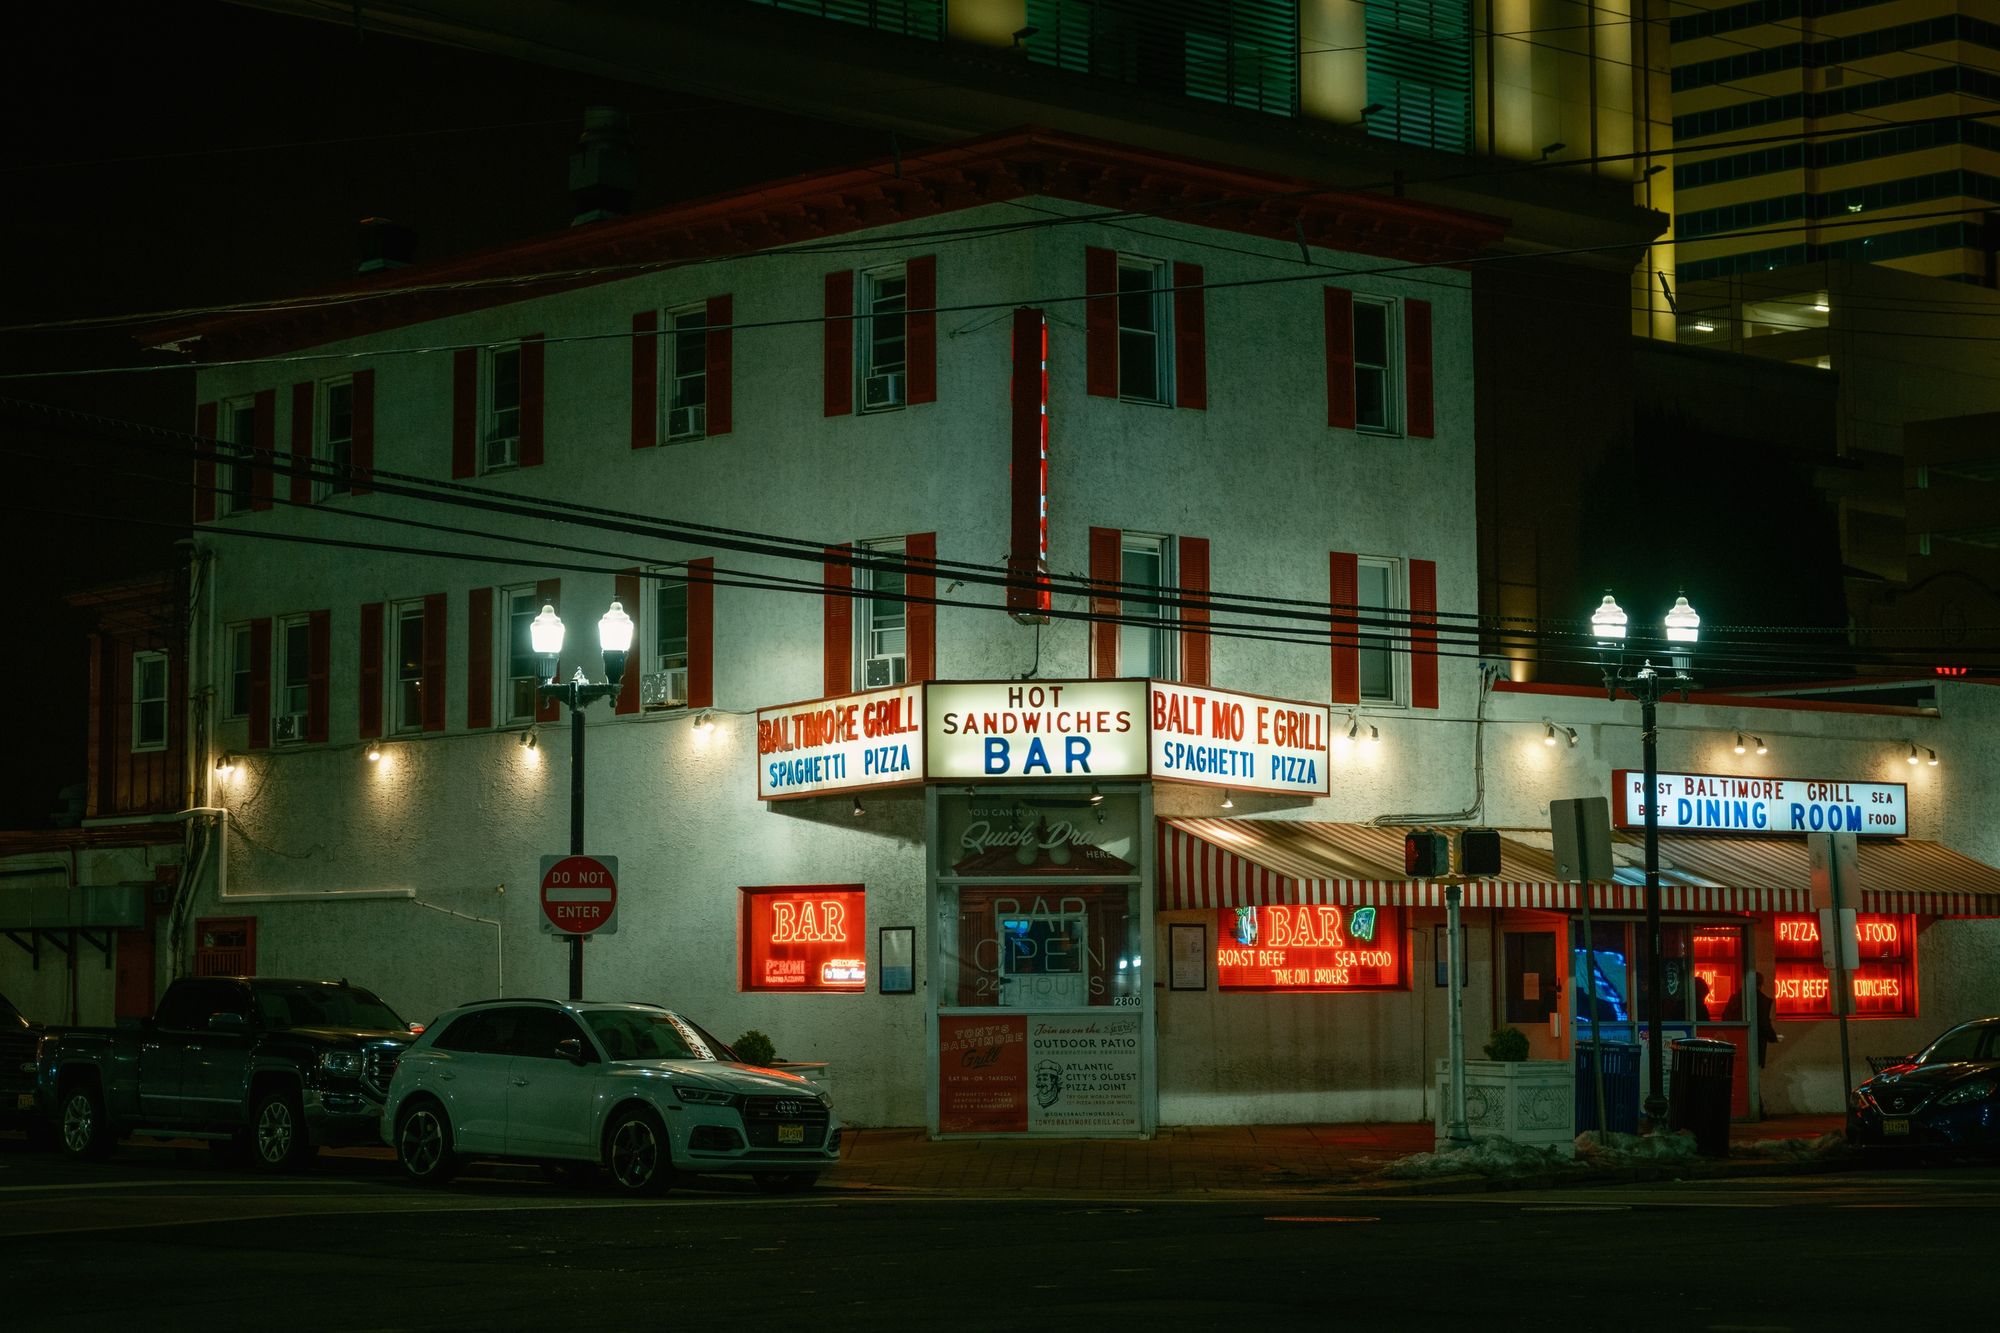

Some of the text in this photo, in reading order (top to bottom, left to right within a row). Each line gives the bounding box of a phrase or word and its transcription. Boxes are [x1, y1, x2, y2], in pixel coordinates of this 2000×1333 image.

[1008, 686, 1063, 708] HOT
[759, 696, 918, 755] BALTIMORE GRILL
[943, 711, 1131, 734] SANDWICHES
[984, 736, 1091, 774] BAR
[1164, 741, 1317, 784] SPAGHETTI PIZZA
[769, 744, 910, 788] SPAGHETTI PIZZA
[1634, 782, 1672, 795] RST
[1685, 777, 1854, 802] BALTIMORE GRILL
[1872, 792, 1893, 804] SEA
[968, 808, 1040, 817] YOU CAN PLAY
[1638, 804, 1668, 817] BEF
[1678, 798, 1862, 832] DINING ROOM
[1868, 813, 1896, 825] FOOD
[960, 820, 1104, 855] Quick Dra
[1086, 850, 1112, 859] HERE
[552, 872, 605, 884] DO NOT
[558, 906, 600, 918] ENTER
[994, 896, 1087, 933] BAR
[772, 901, 846, 942] BAR
[1268, 906, 1343, 947] BAR
[1780, 922, 1818, 941] PIZZA
[1866, 924, 1897, 942] FOOD
[974, 937, 1106, 973] OPEN
[1218, 950, 1392, 967] ROAST BEEF SEA FOOD
[765, 960, 805, 975] PERONI
[1314, 969, 1349, 984] ORDERS
[976, 976, 1105, 997] 24 HOURS
[1775, 979, 1829, 999] OAST BEEF
[1115, 997, 1140, 1006] 2800
[955, 1024, 1009, 1039] TONY'S
[1034, 1023, 1057, 1036] Join
[1086, 1022, 1100, 1034] the
[941, 1032, 1024, 1051] BALTIMORE
[1033, 1038, 1136, 1048] OUTDOOR PATIO
[1066, 1063, 1114, 1071] ATLANTIC
[1066, 1073, 1136, 1081] CITY'S OLDEST
[1066, 1083, 1126, 1091] PIZZA JOINT
